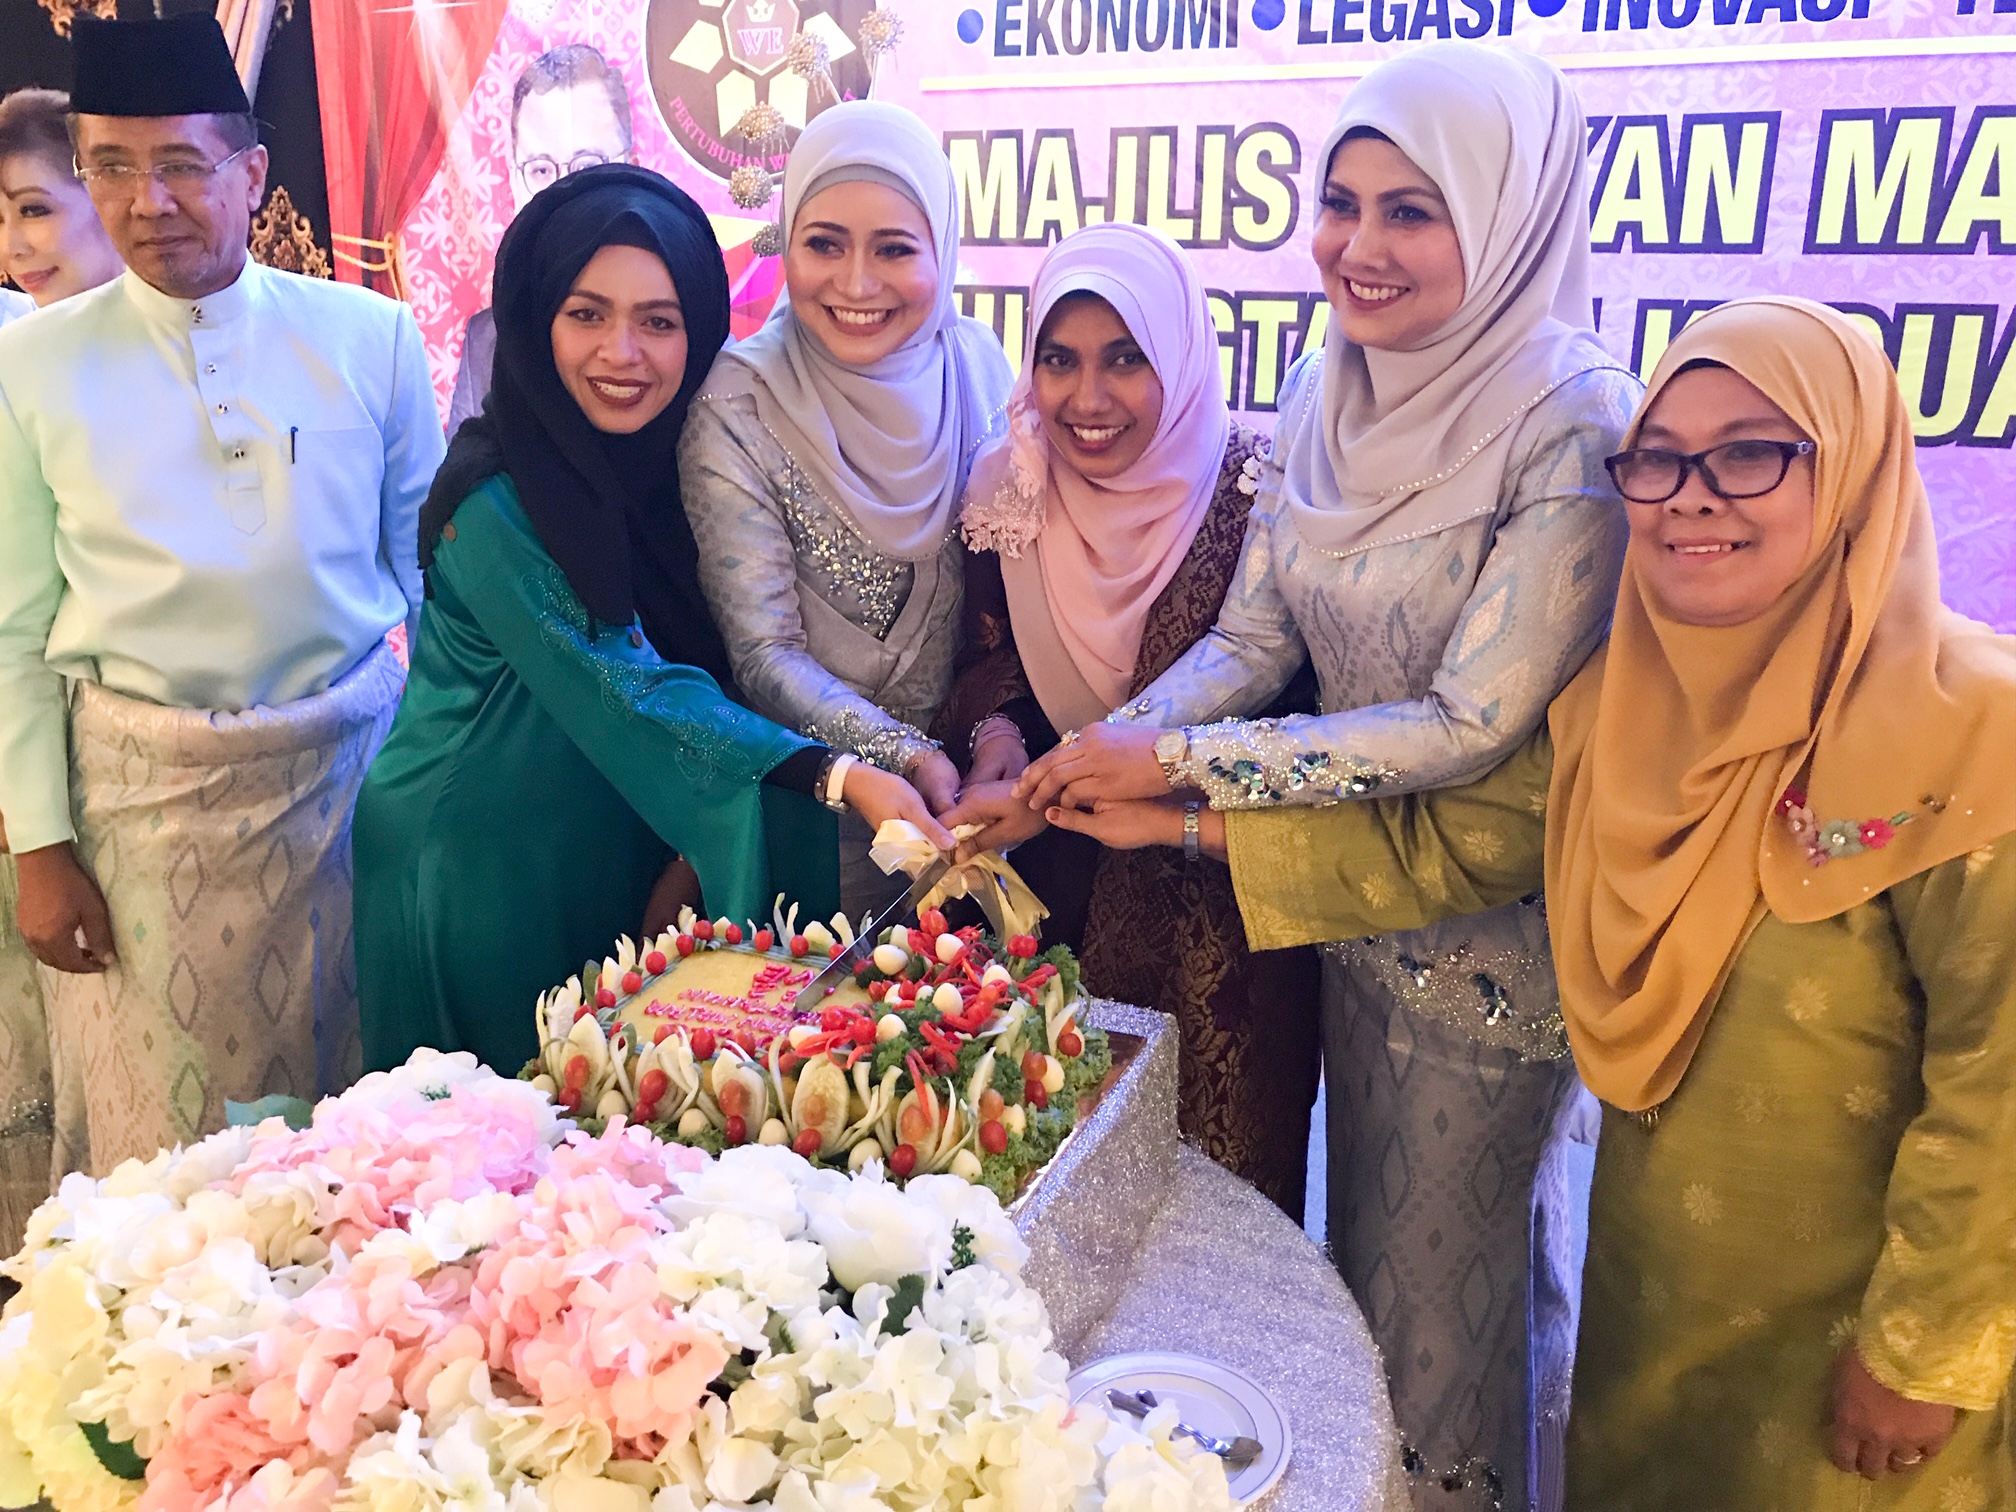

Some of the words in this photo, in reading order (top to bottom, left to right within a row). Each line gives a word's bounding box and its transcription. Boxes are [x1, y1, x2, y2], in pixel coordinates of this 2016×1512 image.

[994, 0, 1238, 57] EKONOMI
[1297, 0, 1516, 45] LEGASI
[944, 122, 1300, 252] MAJLIS
